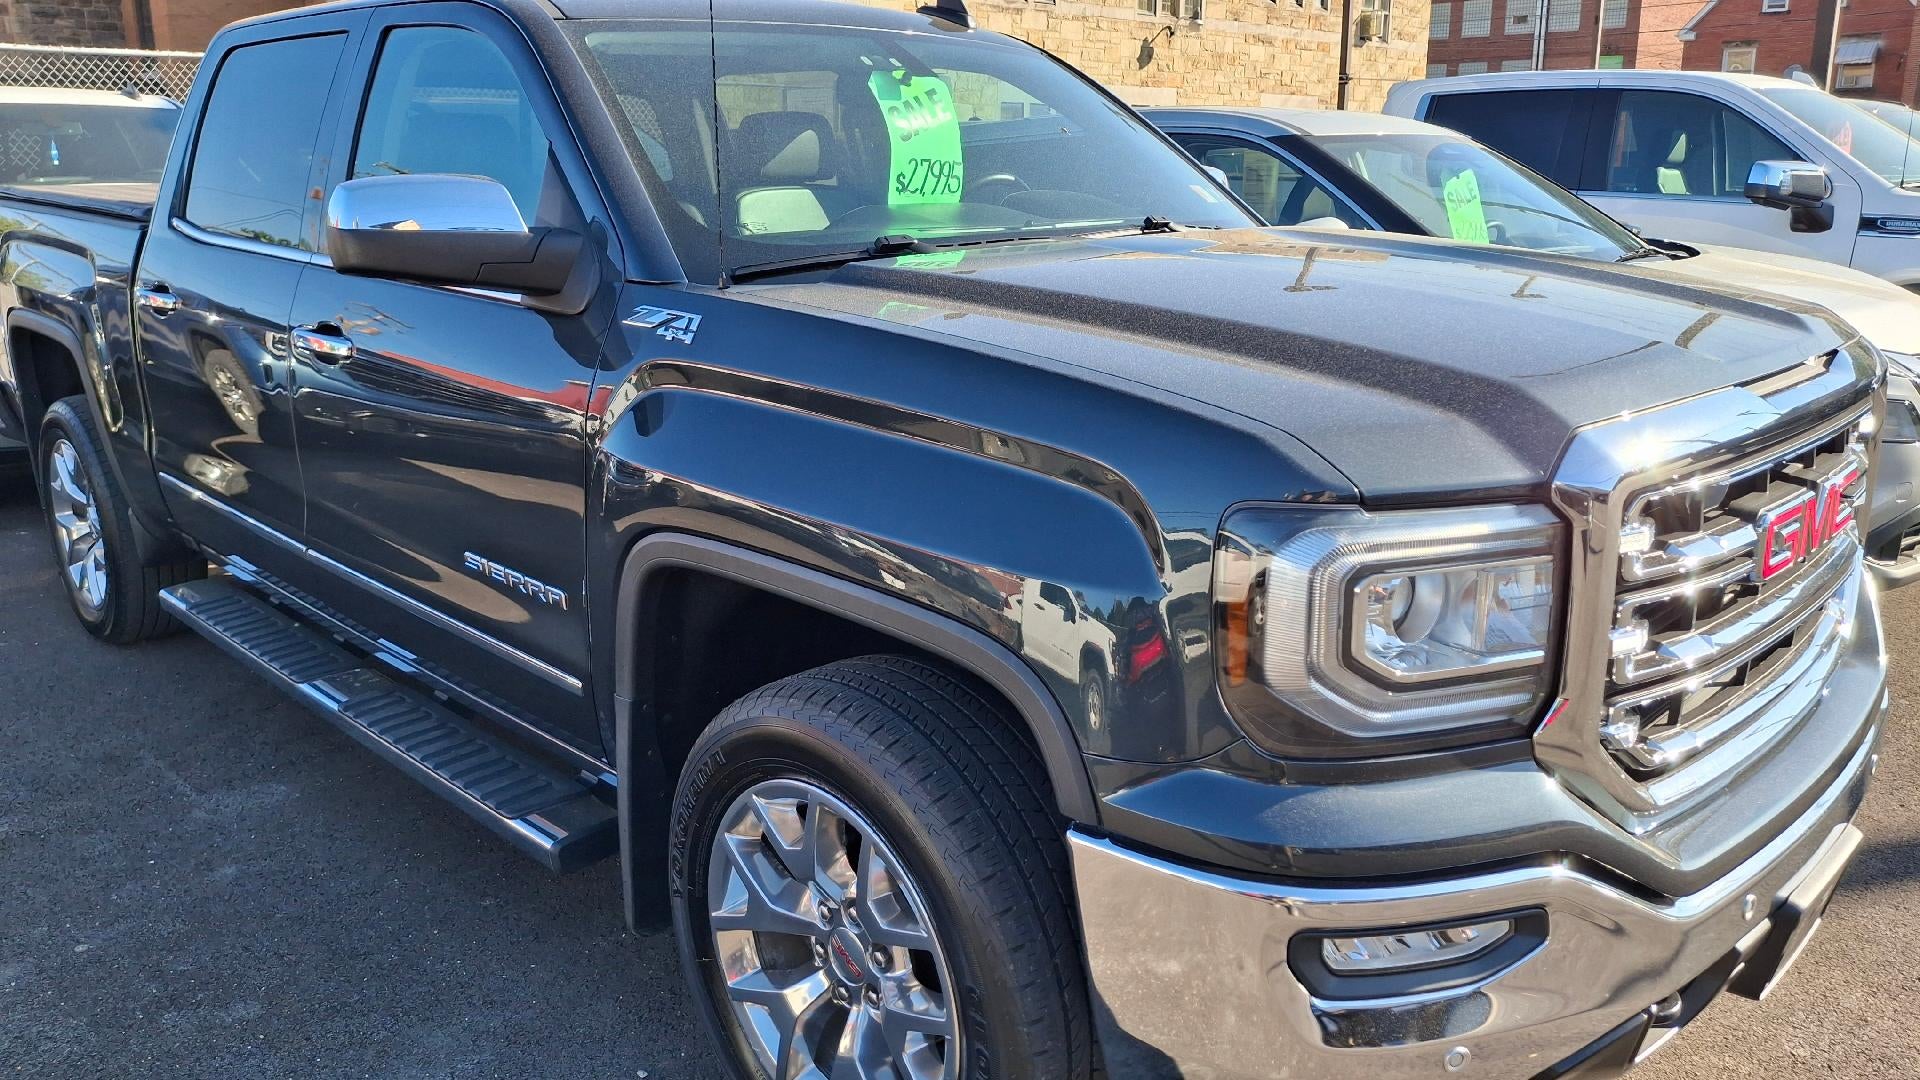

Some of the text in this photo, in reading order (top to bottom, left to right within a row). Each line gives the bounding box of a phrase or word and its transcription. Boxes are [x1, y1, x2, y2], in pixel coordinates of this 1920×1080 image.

[887, 88, 952, 142] SALE
[1447, 181, 1478, 212] SALE
[622, 305, 702, 332] Z71
[1762, 464, 1860, 581] GMC
[463, 551, 568, 611] SIERRA
[832, 934, 865, 979] GMC
